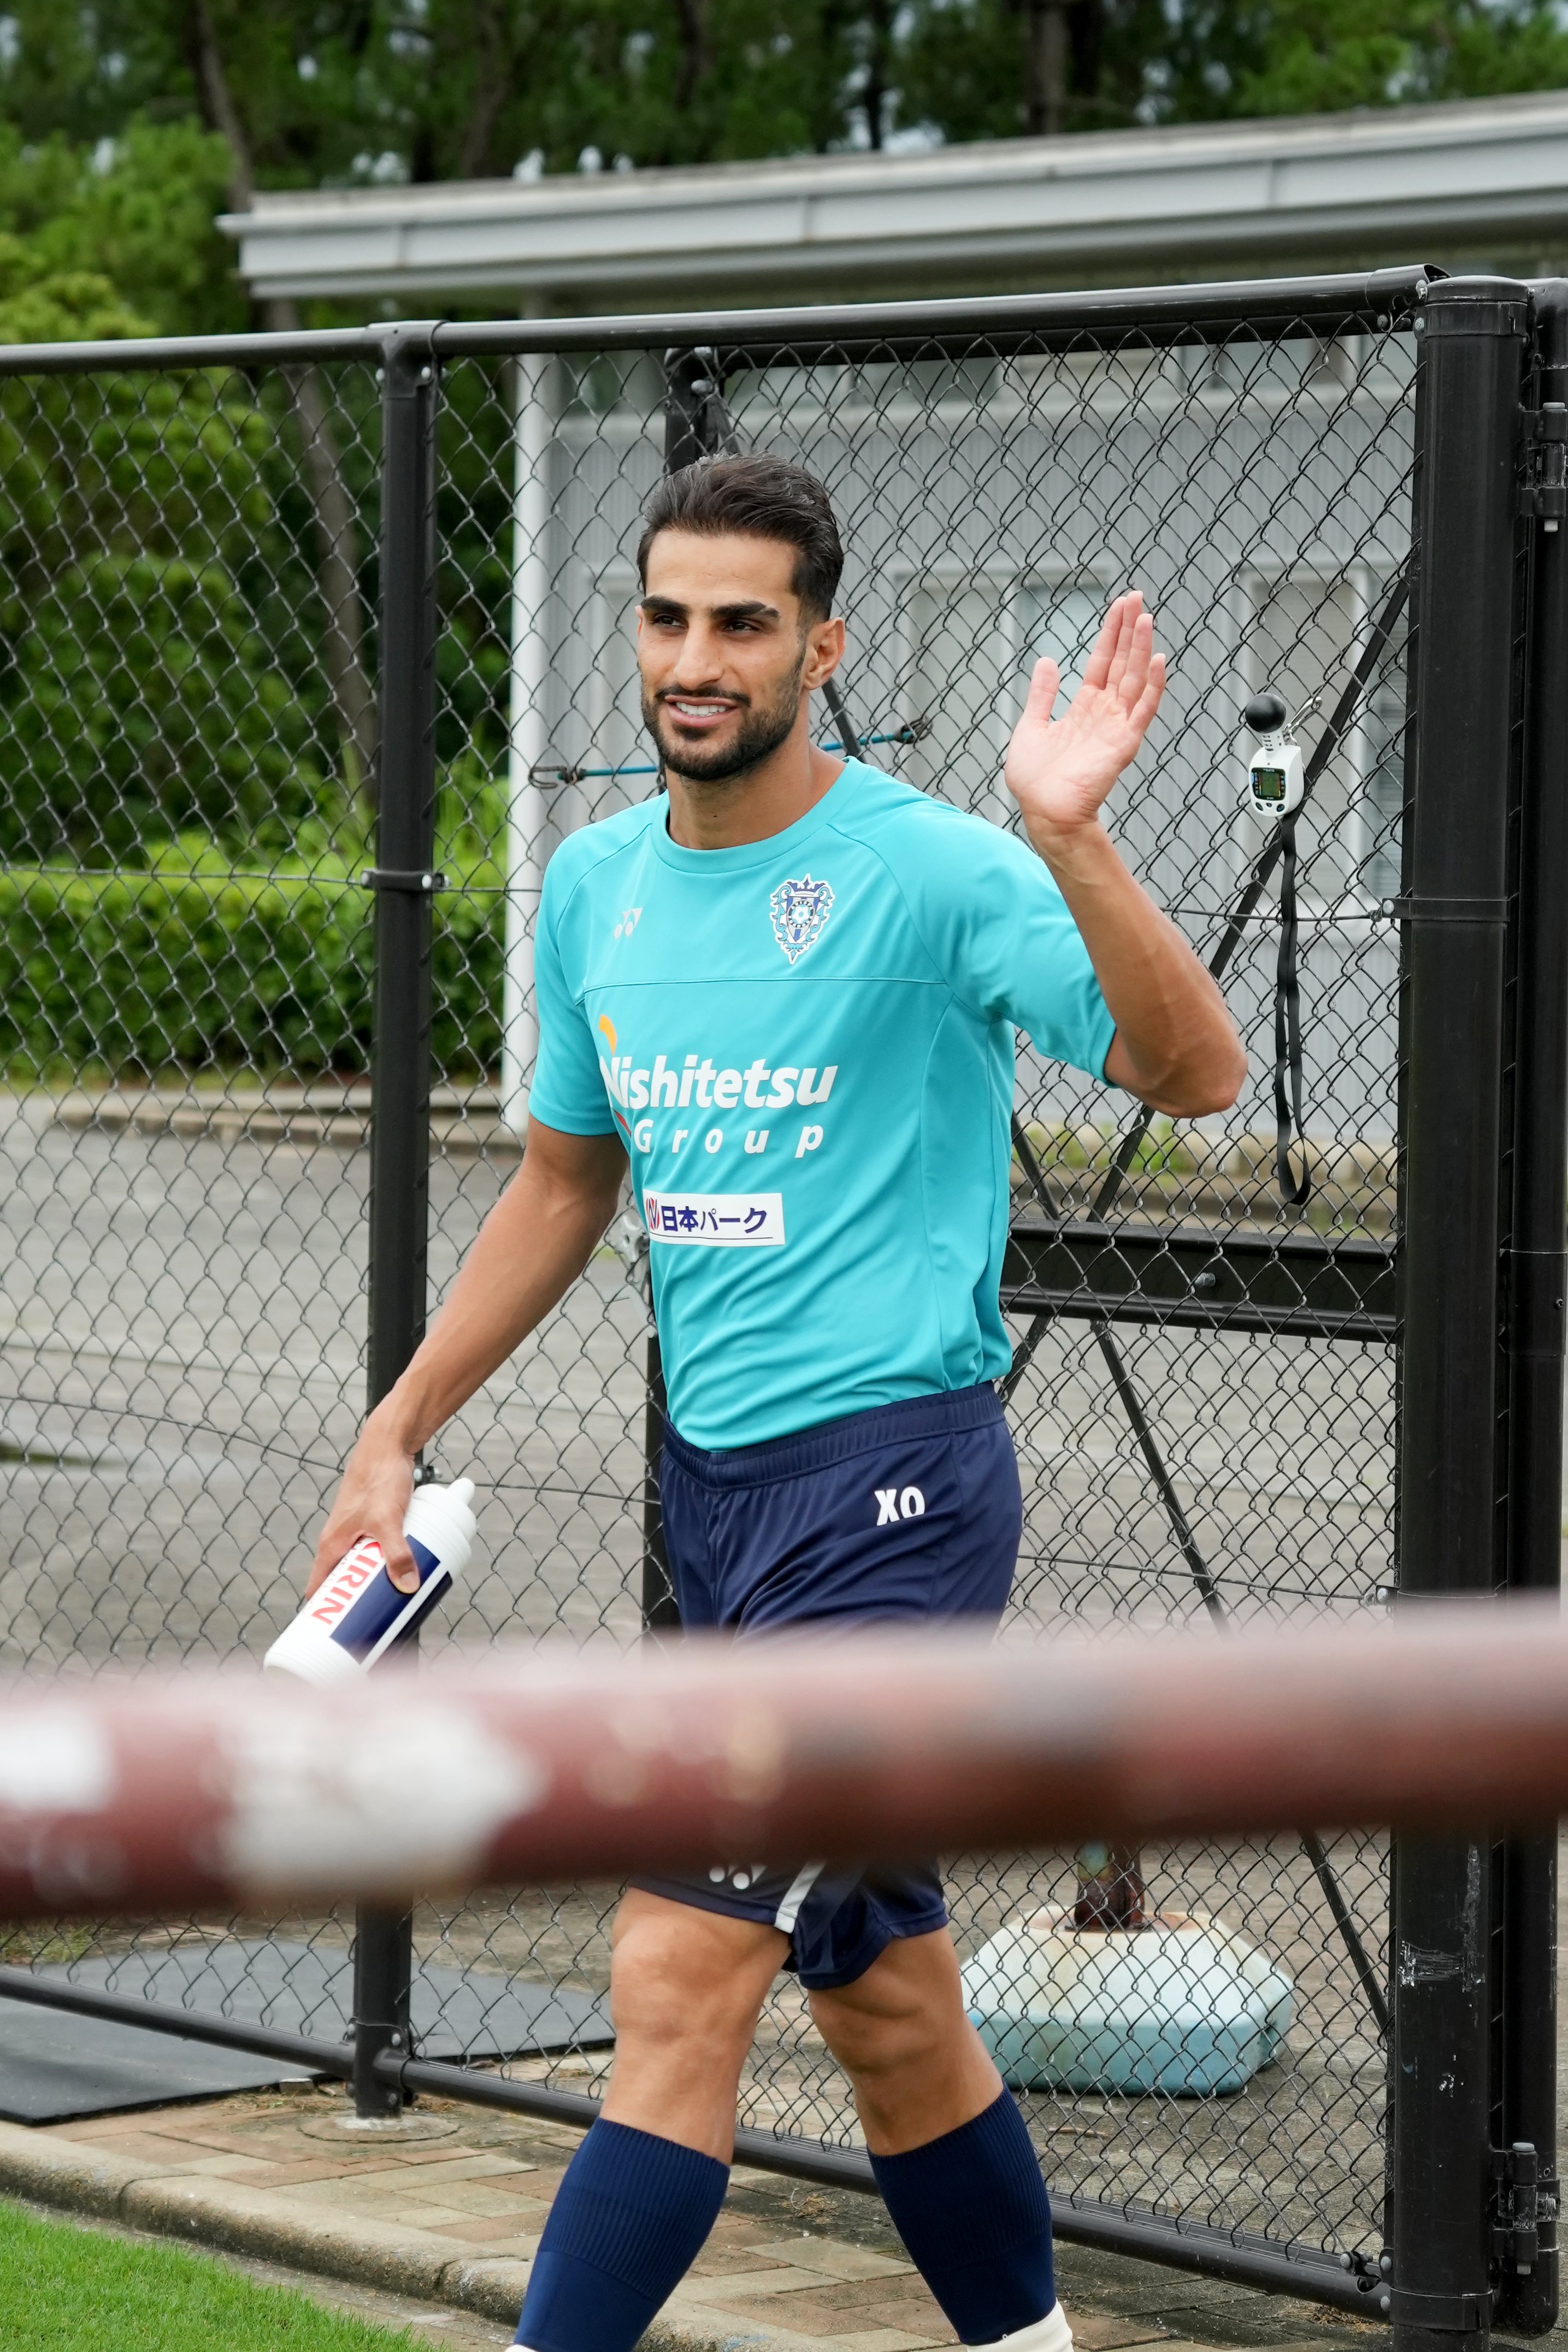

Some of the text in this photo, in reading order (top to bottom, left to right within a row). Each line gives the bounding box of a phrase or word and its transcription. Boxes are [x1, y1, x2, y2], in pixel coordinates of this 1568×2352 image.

[599, 1054, 839, 1110] Nishitetsu
[634, 1118, 824, 1159] Group
[661, 1205, 767, 1234] 日本パーク
